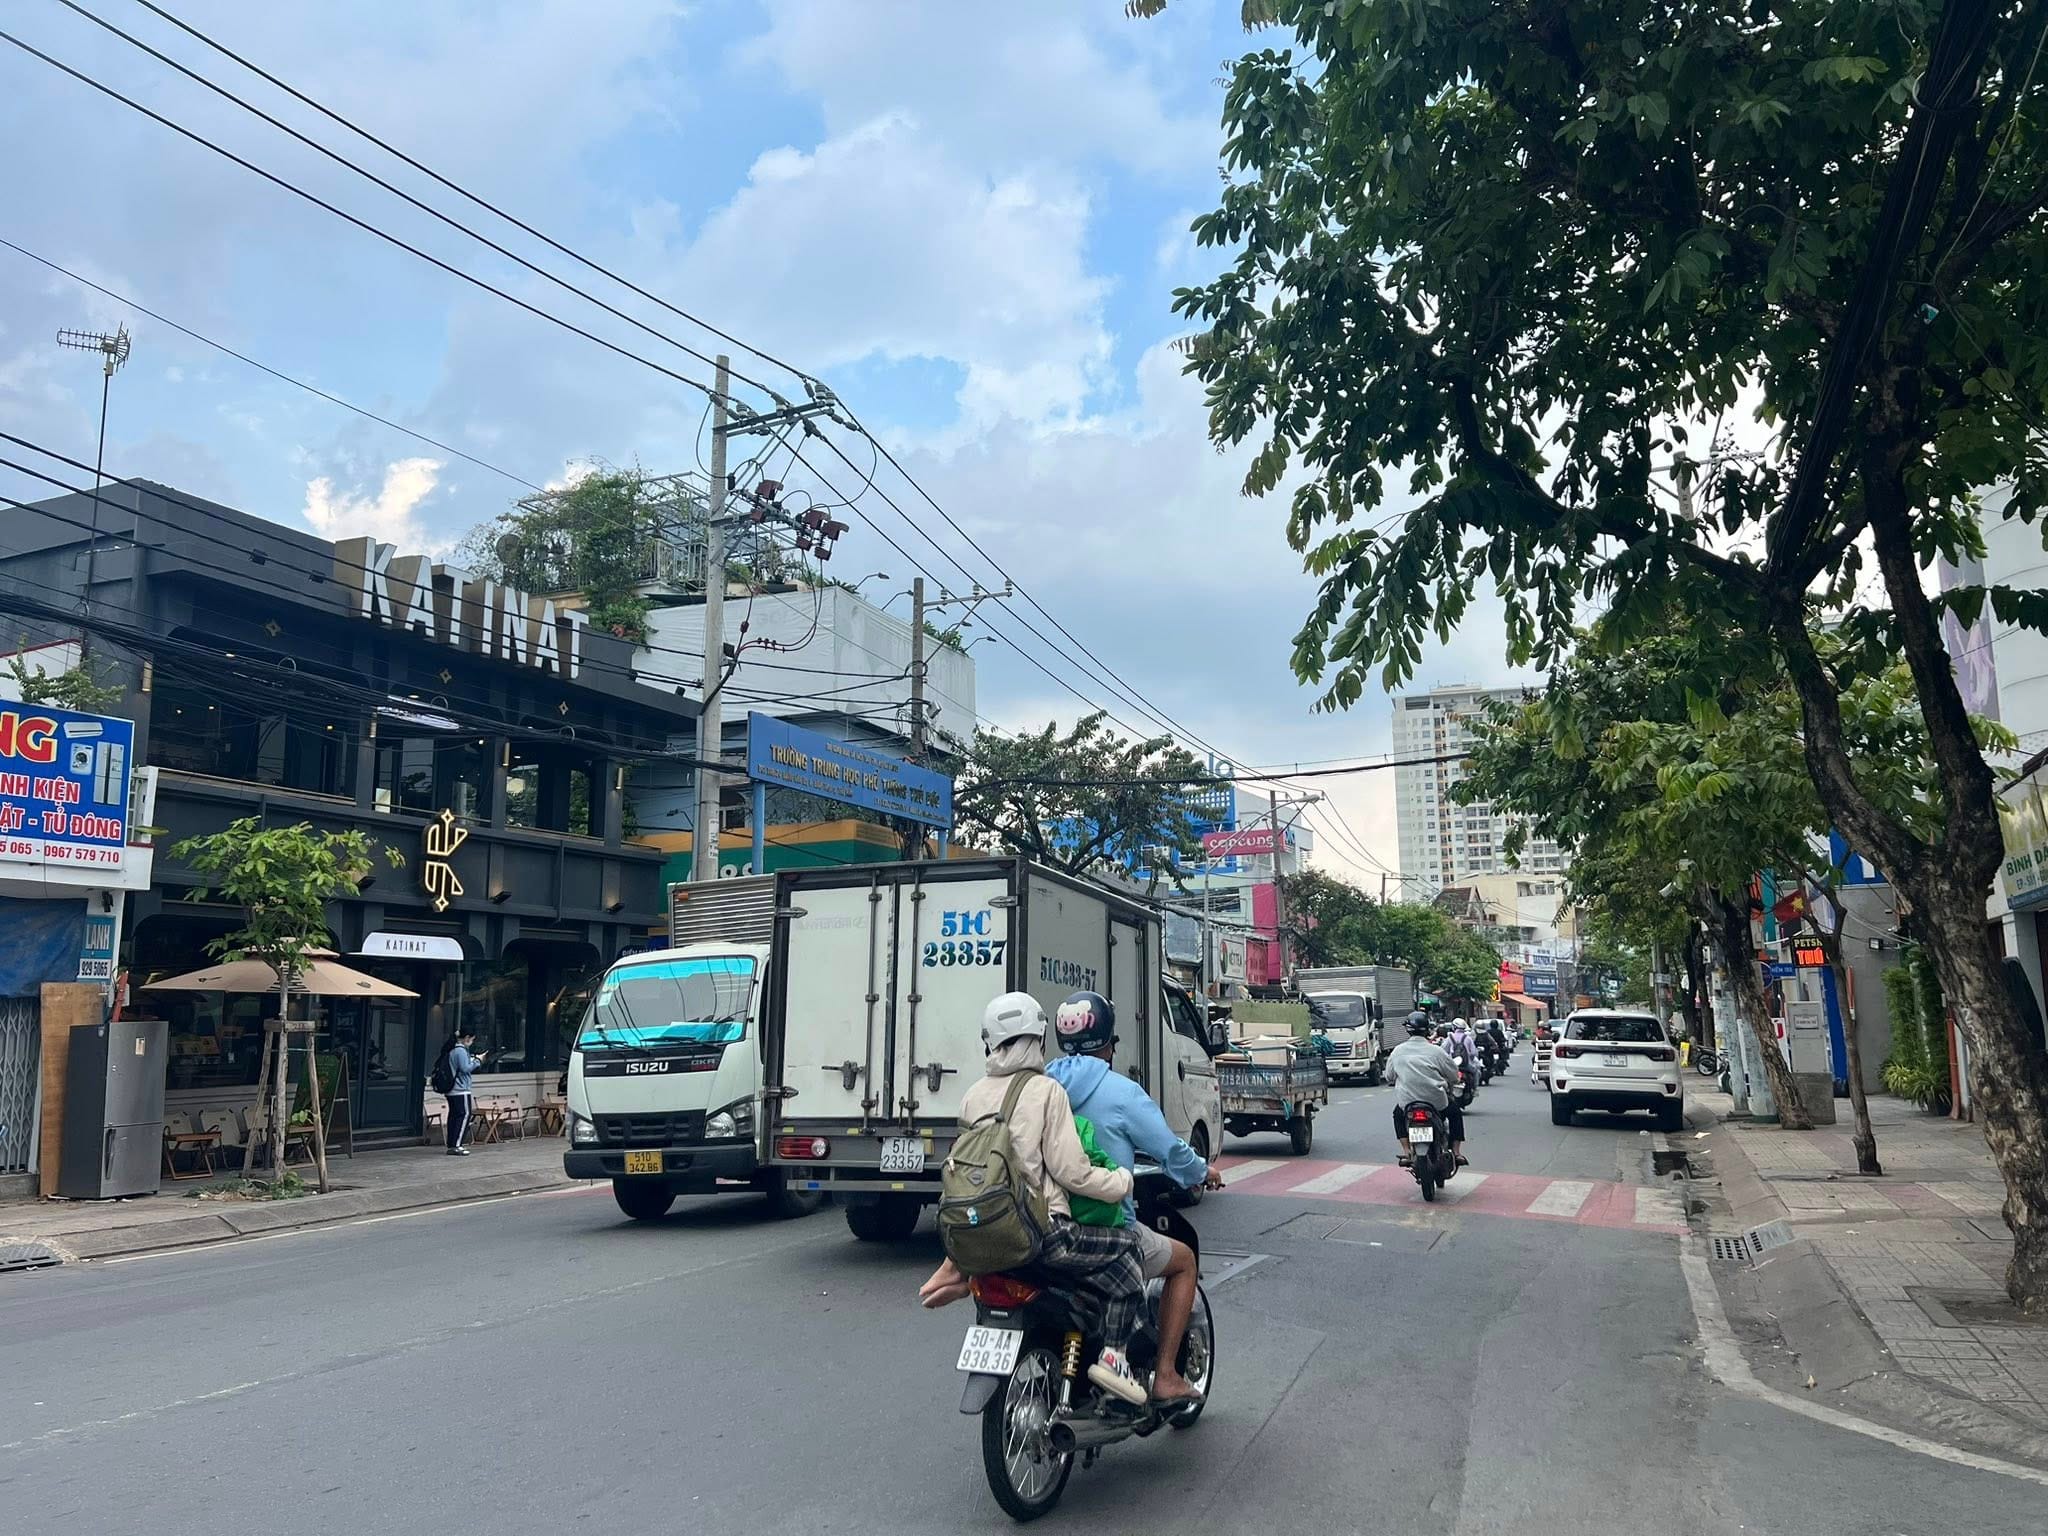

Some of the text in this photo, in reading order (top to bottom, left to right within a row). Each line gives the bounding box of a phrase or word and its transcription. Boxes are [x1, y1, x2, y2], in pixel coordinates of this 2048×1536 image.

[361, 536, 590, 680] KATINAT
[770, 743, 808, 771] TRƯỜNG
[811, 757, 840, 779] TRUNG
[843, 766, 860, 788] HỌC
[862, 769, 879, 792] PHỔ
[33, 775, 81, 806] KIỆN
[42, 807, 67, 835] TỦ
[70, 812, 122, 840] ĐÔNG
[9, 843, 32, 856] 065
[44, 845, 72, 860] 0967
[75, 848, 96, 862] 579
[100, 850, 120, 864] 710
[2006, 853, 2033, 876] BÌNH
[385, 939, 427, 953] KATINAT
[922, 939, 1008, 968] 23357
[81, 960, 109, 977] 929 5065
[626, 1061, 669, 1074] ISUZU
[892, 1139, 915, 1154] 51C
[882, 1155, 922, 1170] 233.57
[970, 1328, 1012, 1351] 50-AA
[960, 1349, 1012, 1371] 938.36
